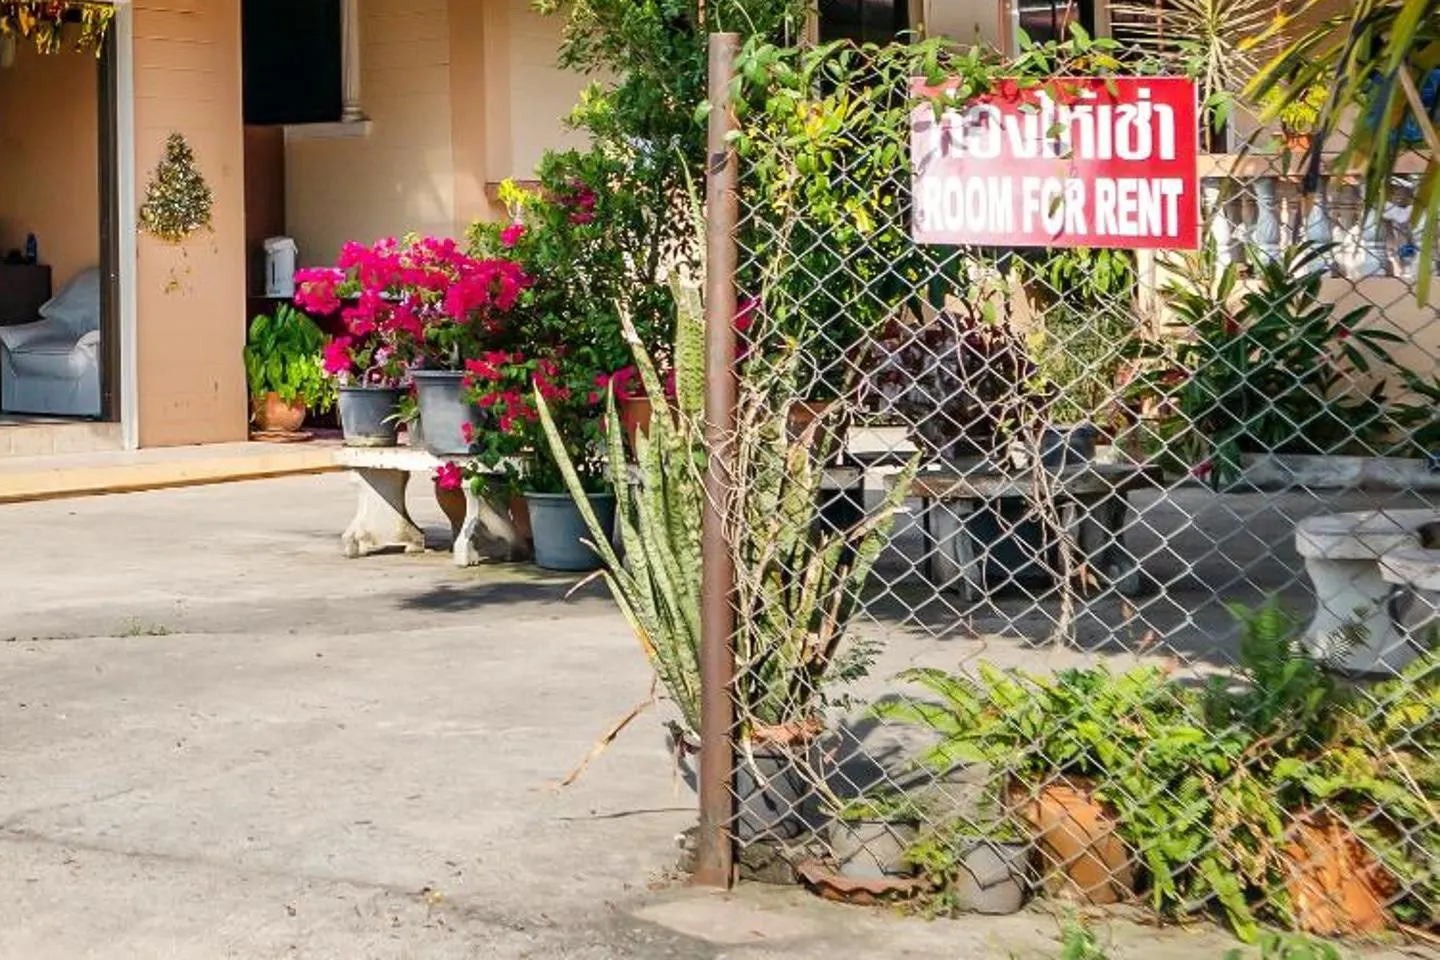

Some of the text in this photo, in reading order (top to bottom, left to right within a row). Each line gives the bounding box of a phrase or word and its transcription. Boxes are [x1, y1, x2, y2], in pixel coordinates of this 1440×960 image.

[923, 176, 1183, 238] ROOM FOR RENT
